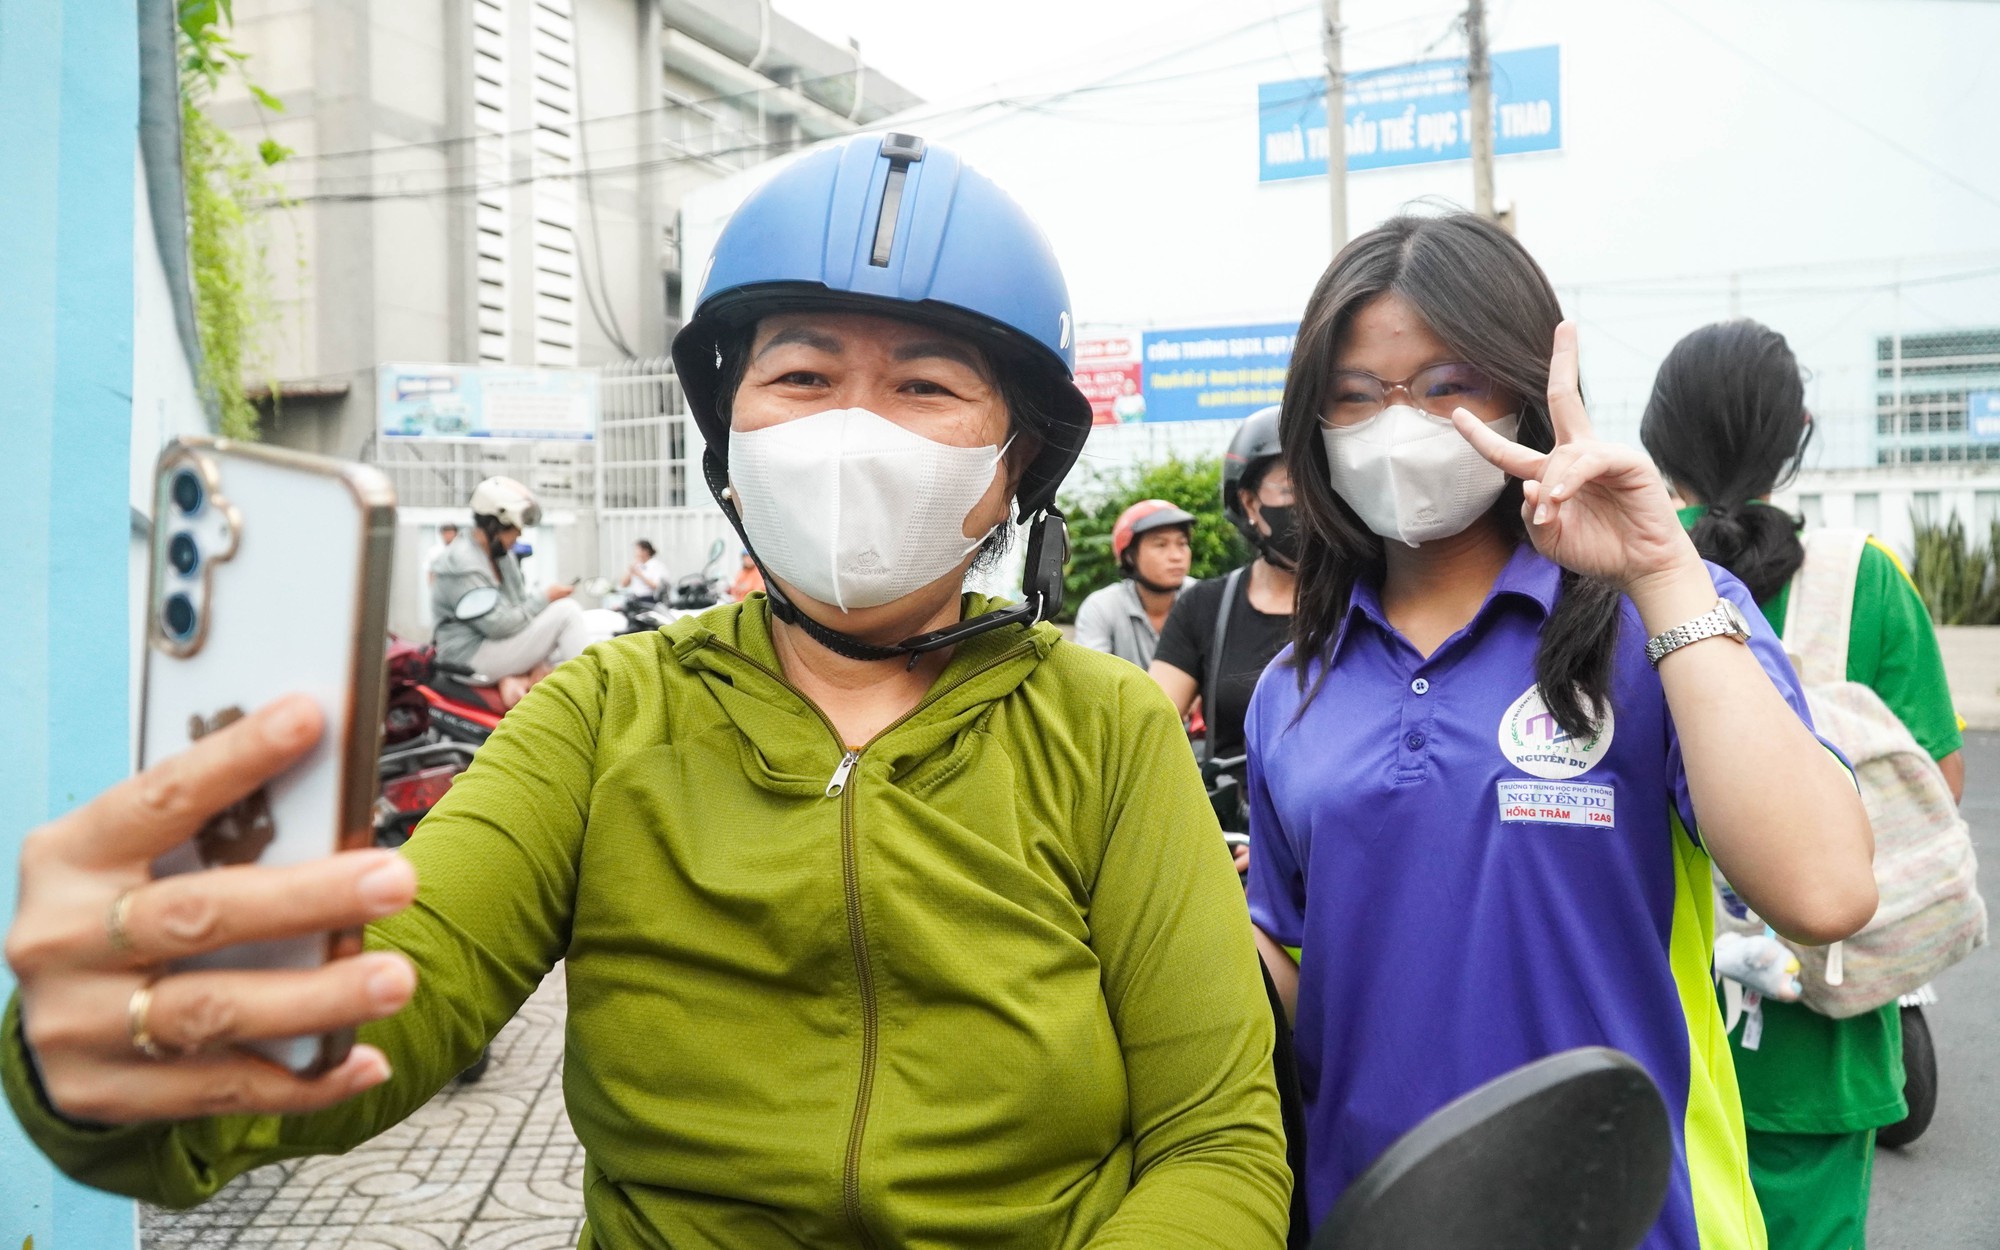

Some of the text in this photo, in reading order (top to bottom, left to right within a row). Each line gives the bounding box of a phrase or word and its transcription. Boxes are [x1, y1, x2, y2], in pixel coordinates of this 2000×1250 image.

[1307, 126, 1330, 159] TH
[1418, 111, 1457, 152] DỤC
[1500, 99, 1551, 138] THAO
[1569, 758, 1588, 769] DU
[1556, 785, 1571, 793] HỌC
[1590, 787, 1613, 797] THÔNG
[1507, 792, 1606, 807] NGUYỄN DU
[1506, 805, 1571, 819] HỒNG TRÂM
[1588, 812, 1612, 823] 12A9
